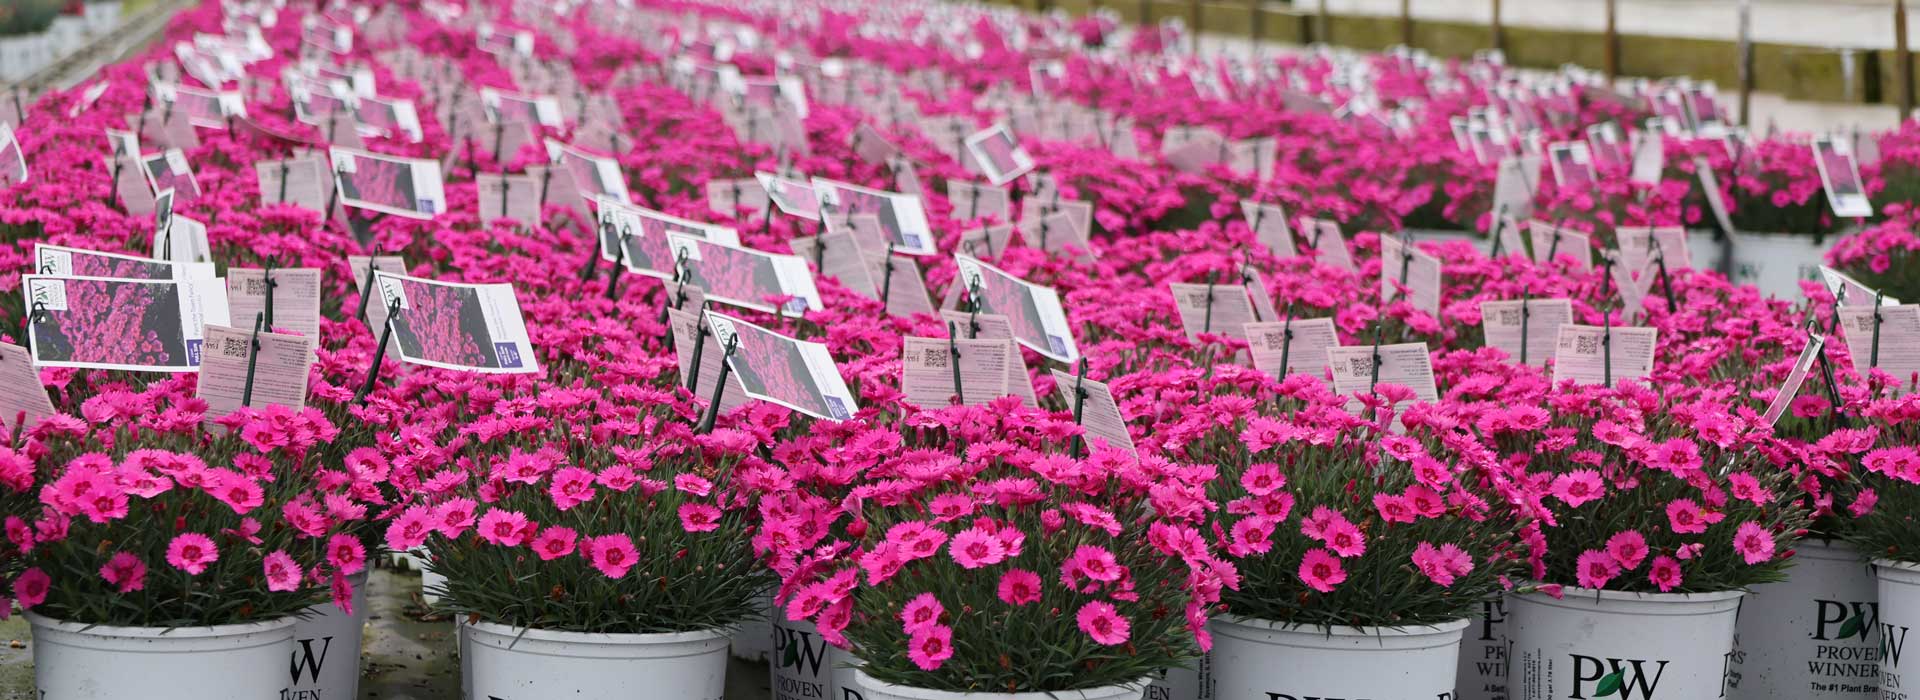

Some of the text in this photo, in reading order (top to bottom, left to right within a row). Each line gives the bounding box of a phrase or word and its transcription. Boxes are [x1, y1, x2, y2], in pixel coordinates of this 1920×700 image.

[1568, 653, 1670, 700] PW
[1811, 682, 1827, 691] The
[1841, 684, 1861, 693] Plant
